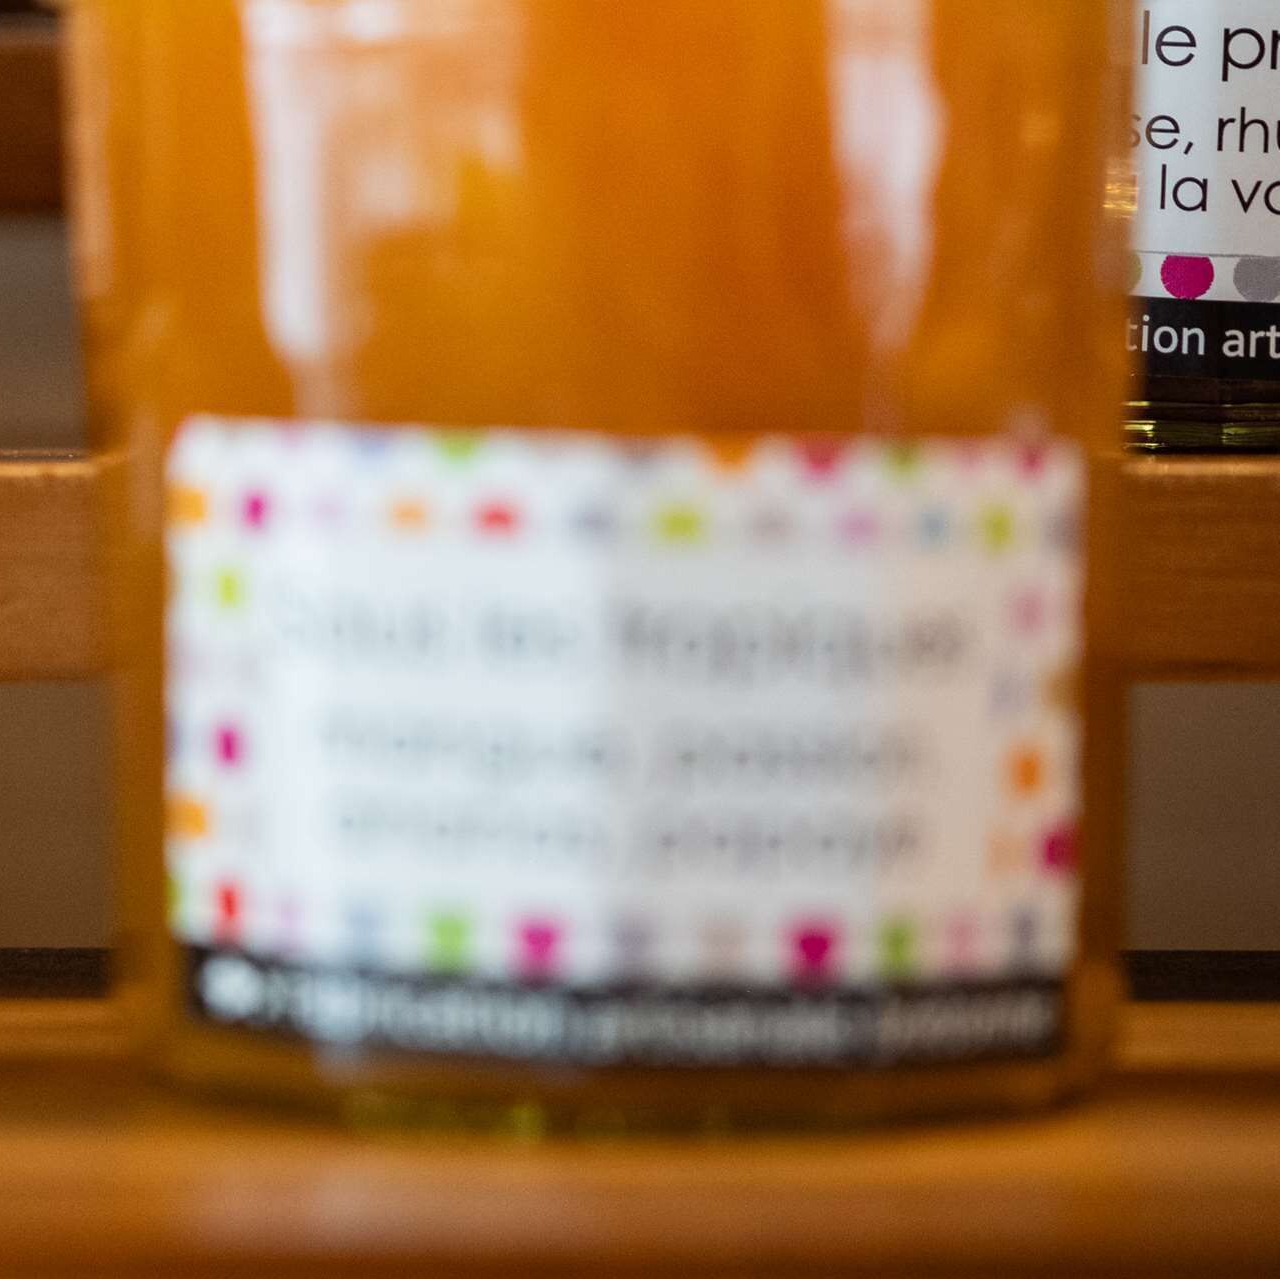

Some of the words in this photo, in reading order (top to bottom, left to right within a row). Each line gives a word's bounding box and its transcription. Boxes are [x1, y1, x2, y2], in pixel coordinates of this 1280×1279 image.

[1142, 9, 1197, 67] le
[1217, 106, 1280, 154] rh
[1159, 163, 1209, 213] la
